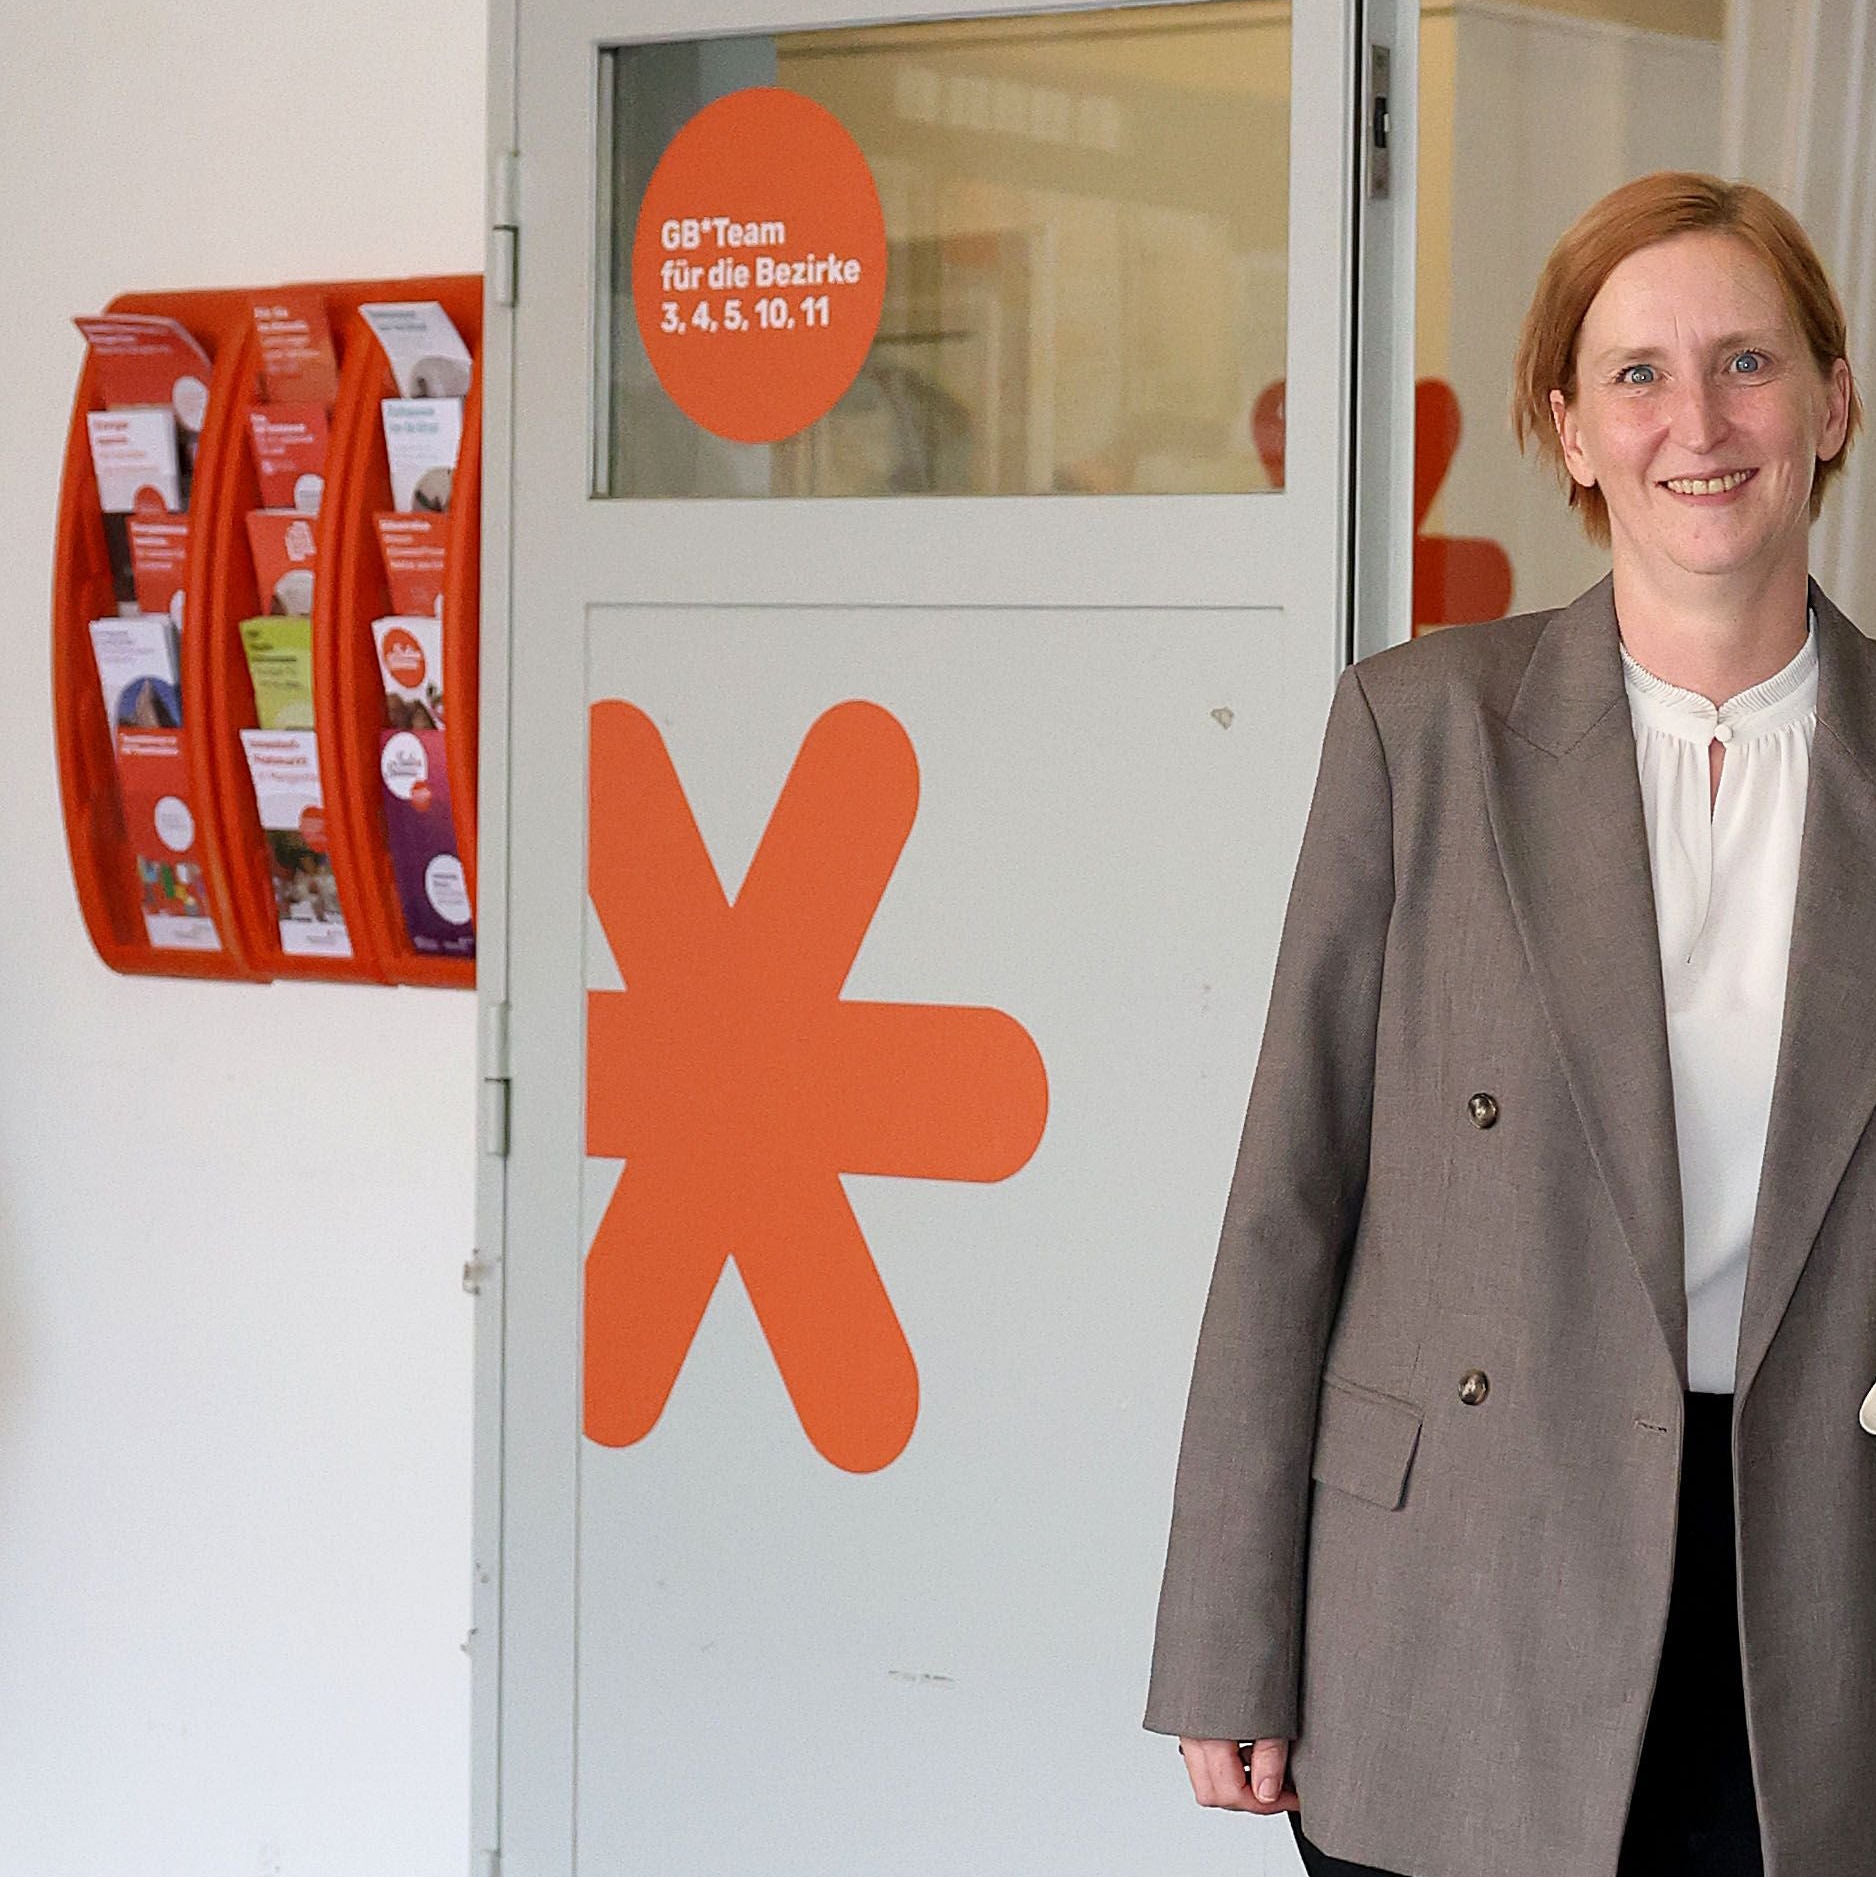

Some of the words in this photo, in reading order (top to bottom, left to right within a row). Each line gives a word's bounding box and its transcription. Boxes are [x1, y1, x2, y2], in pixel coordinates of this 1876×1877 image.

[660, 259, 703, 292] für
[708, 256, 750, 290] die
[755, 252, 862, 288] Bezirke
[660, 300, 687, 336] 3,
[691, 300, 718, 333] 4,
[723, 298, 750, 332] 5,
[755, 296, 795, 330] 10,
[800, 295, 830, 328] 11
